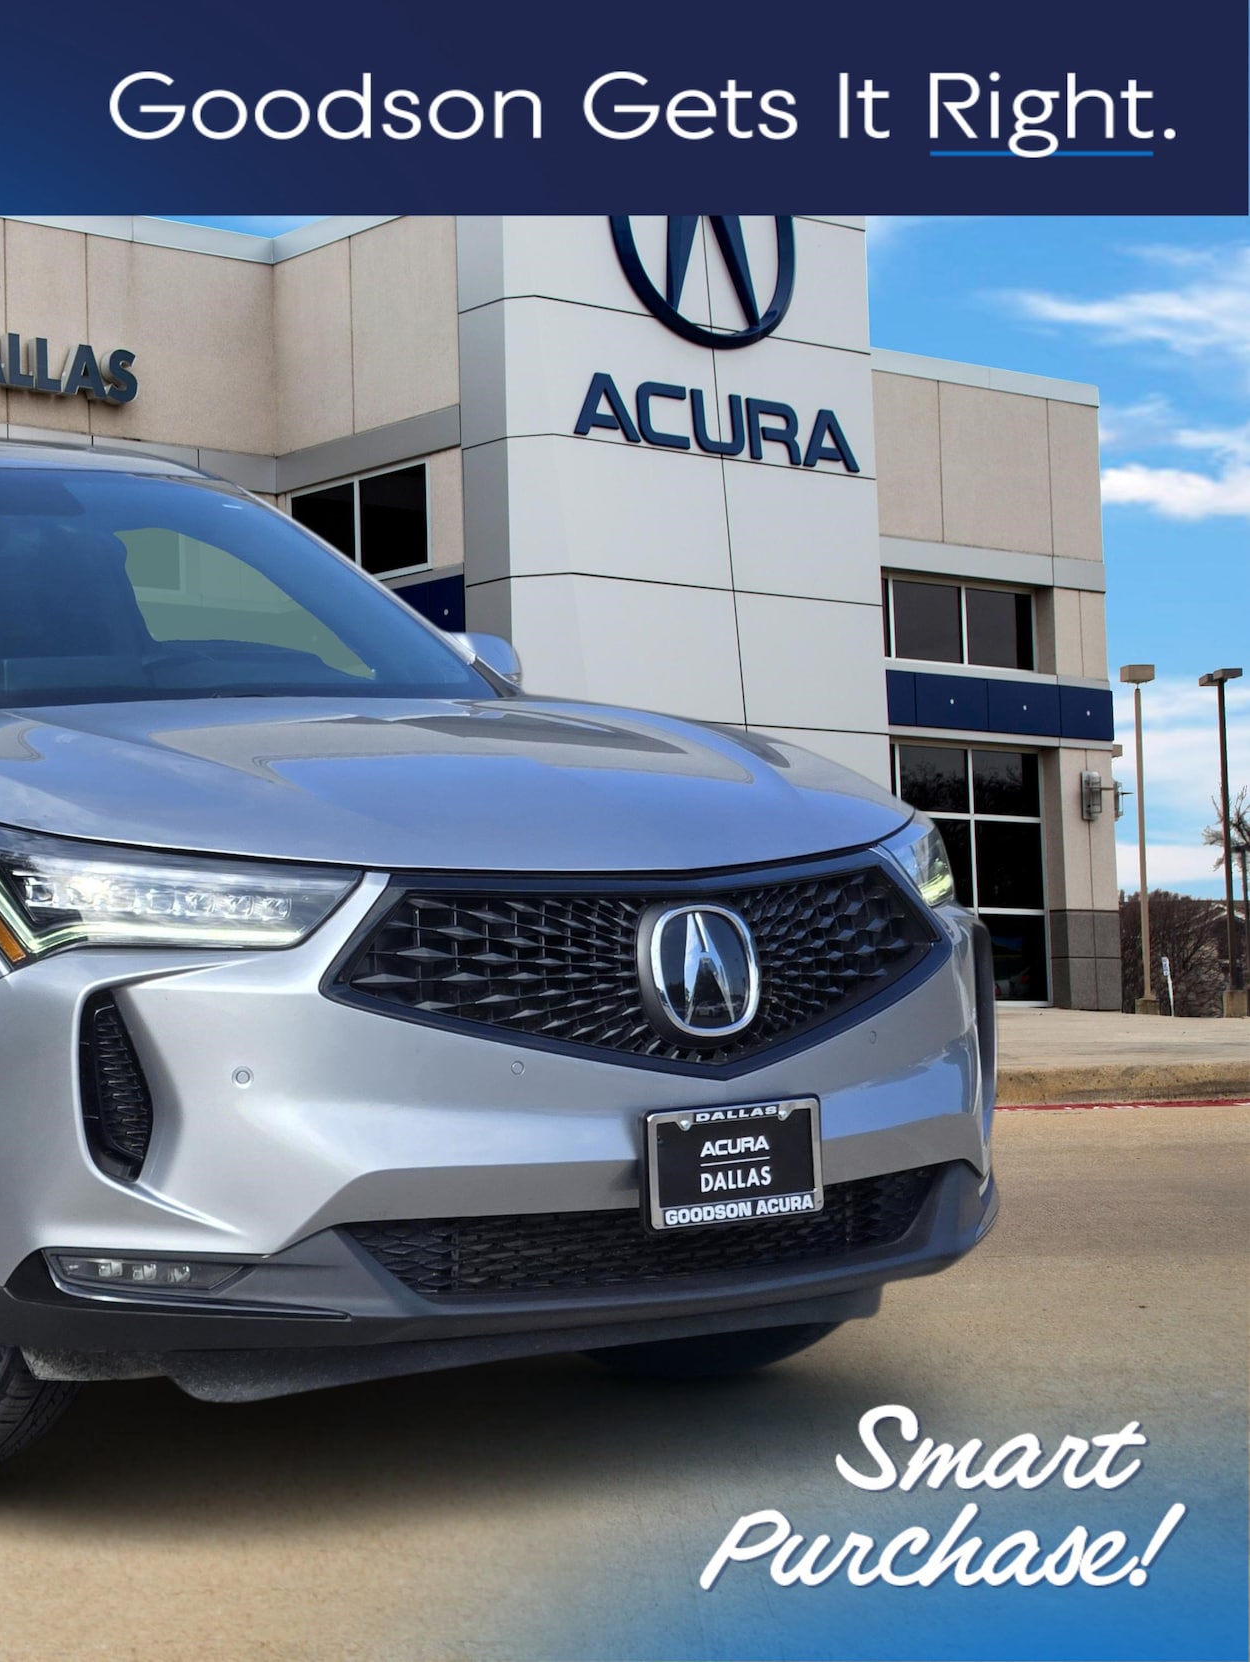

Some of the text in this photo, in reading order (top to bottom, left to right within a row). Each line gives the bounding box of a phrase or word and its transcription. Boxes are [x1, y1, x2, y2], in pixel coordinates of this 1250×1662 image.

[573, 371, 861, 474] ACURA
[696, 1106, 778, 1122] DALLAS
[700, 1135, 769, 1157] ACURA
[700, 1165, 772, 1193] DALLAS
[665, 1194, 814, 1225] GOODSON ACURA
